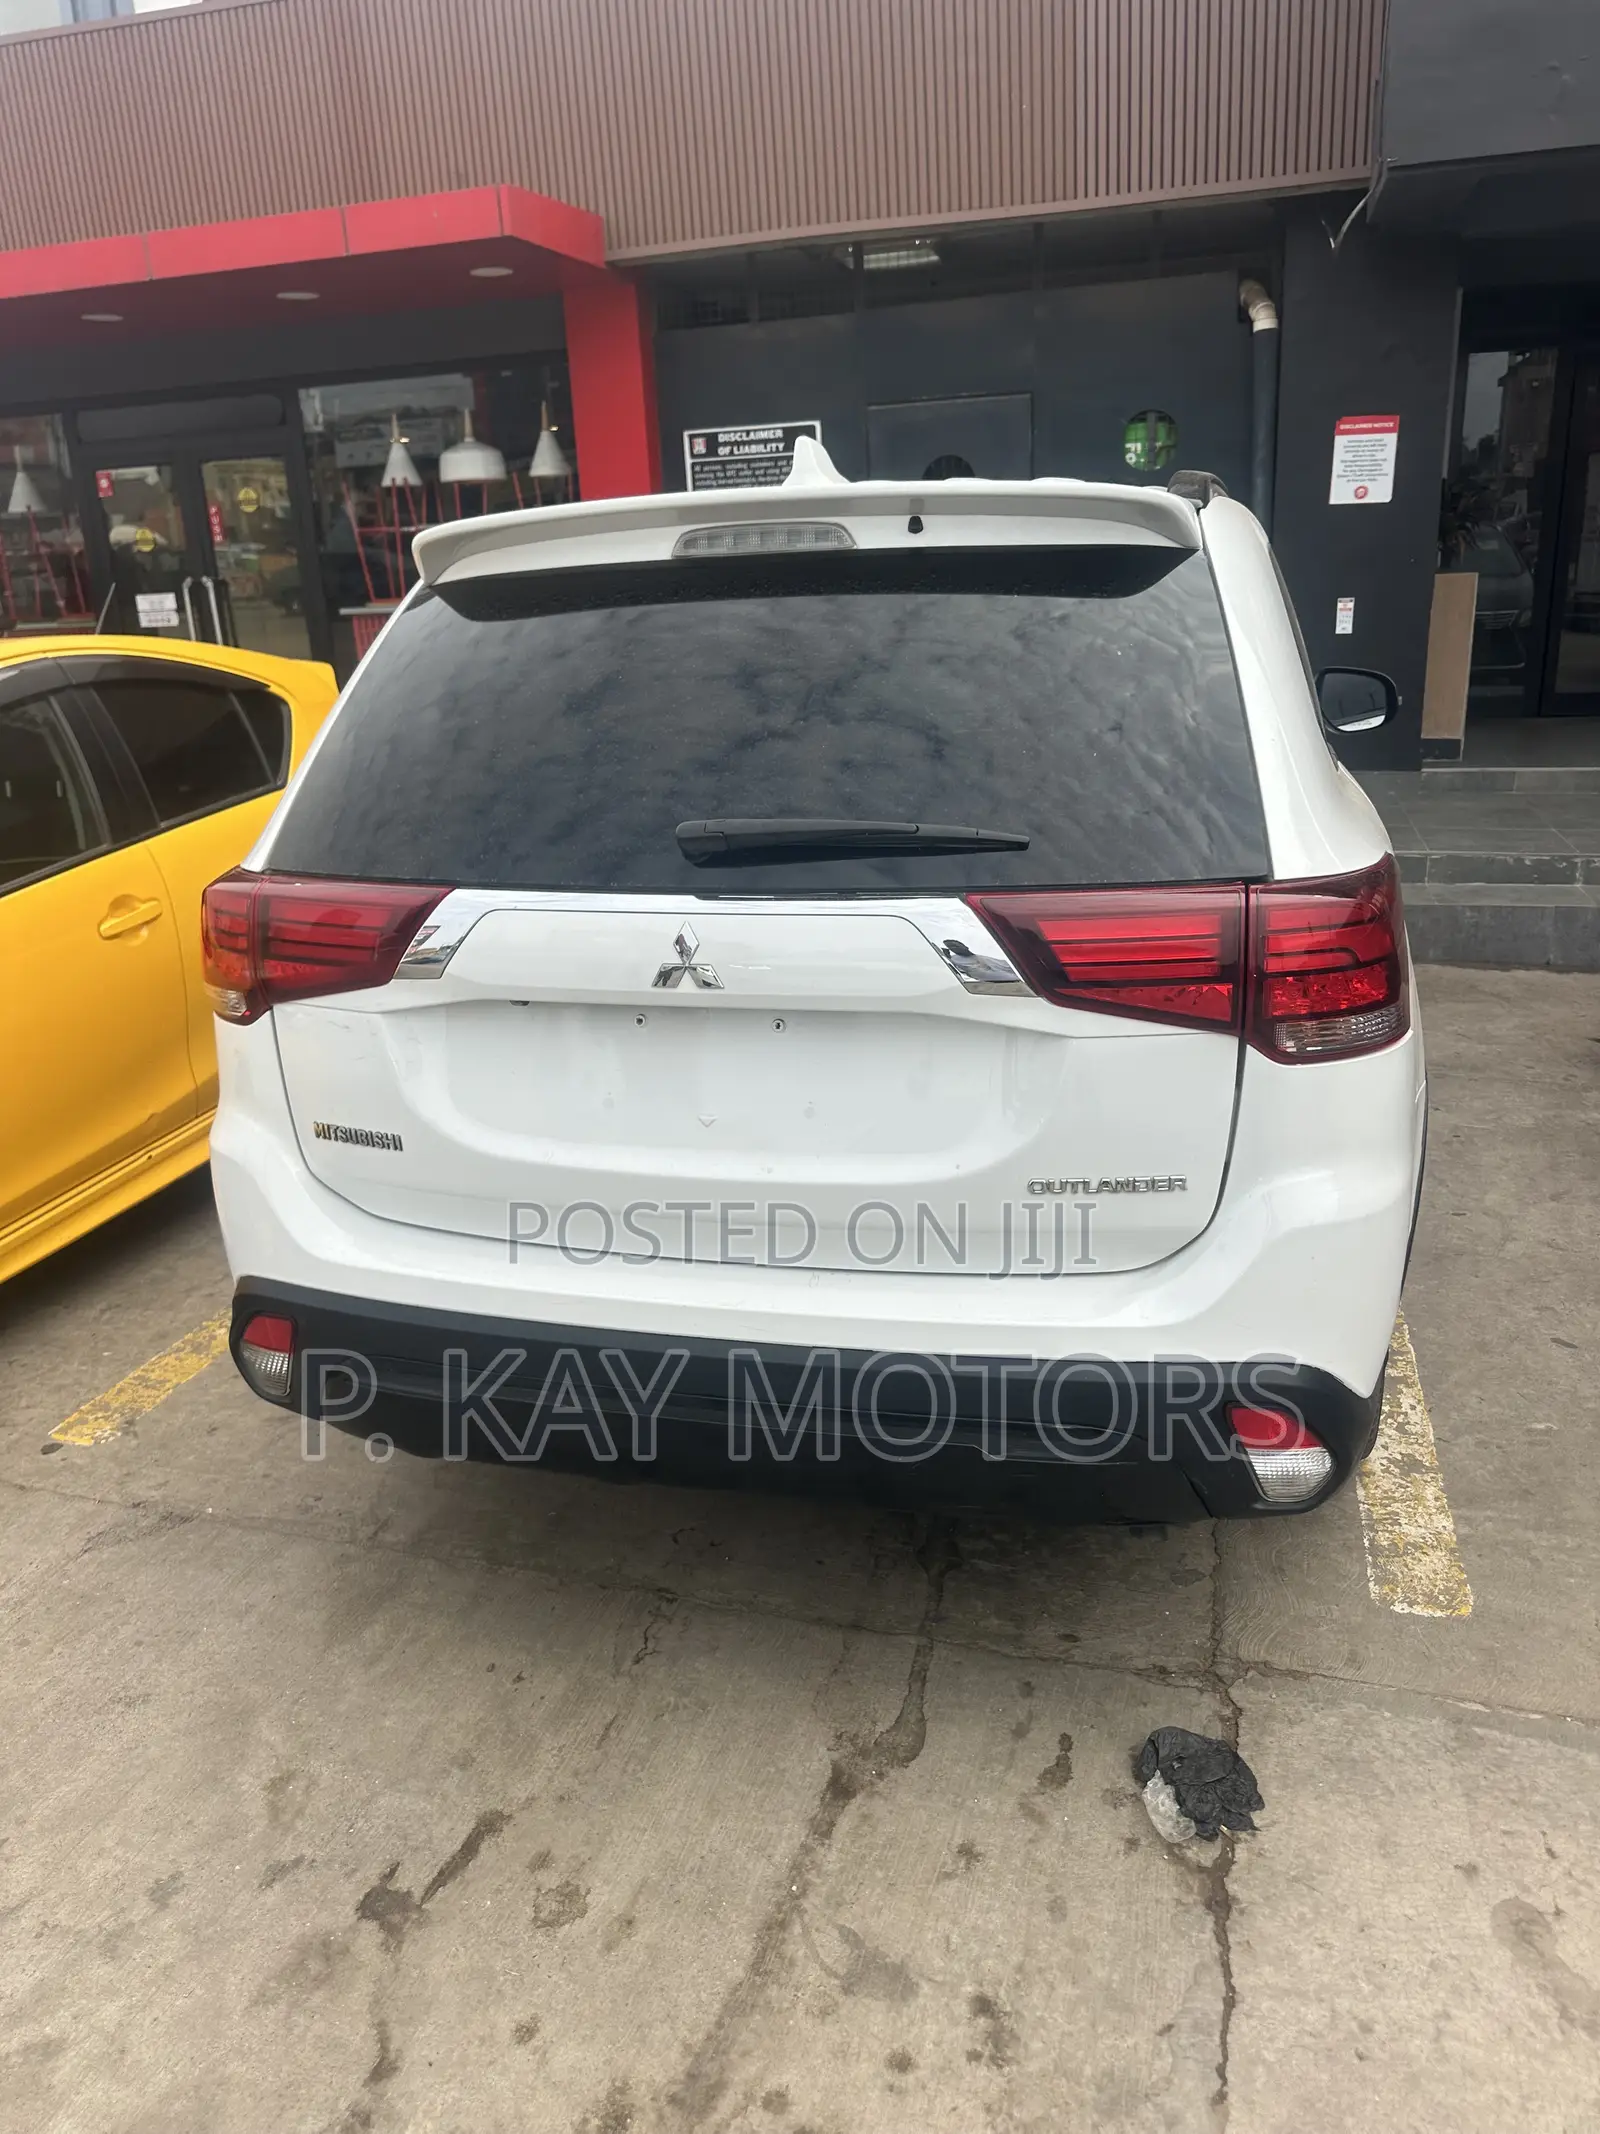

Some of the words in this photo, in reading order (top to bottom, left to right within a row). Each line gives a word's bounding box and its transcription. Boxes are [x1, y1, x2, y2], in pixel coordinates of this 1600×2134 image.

[717, 429, 783, 442] DISCLAIMER
[717, 446, 732, 456] OF
[733, 442, 785, 455] LIABILITY
[313, 1121, 403, 1152] MITSUBISHI
[1027, 1174, 1188, 1195] OUTLANDER
